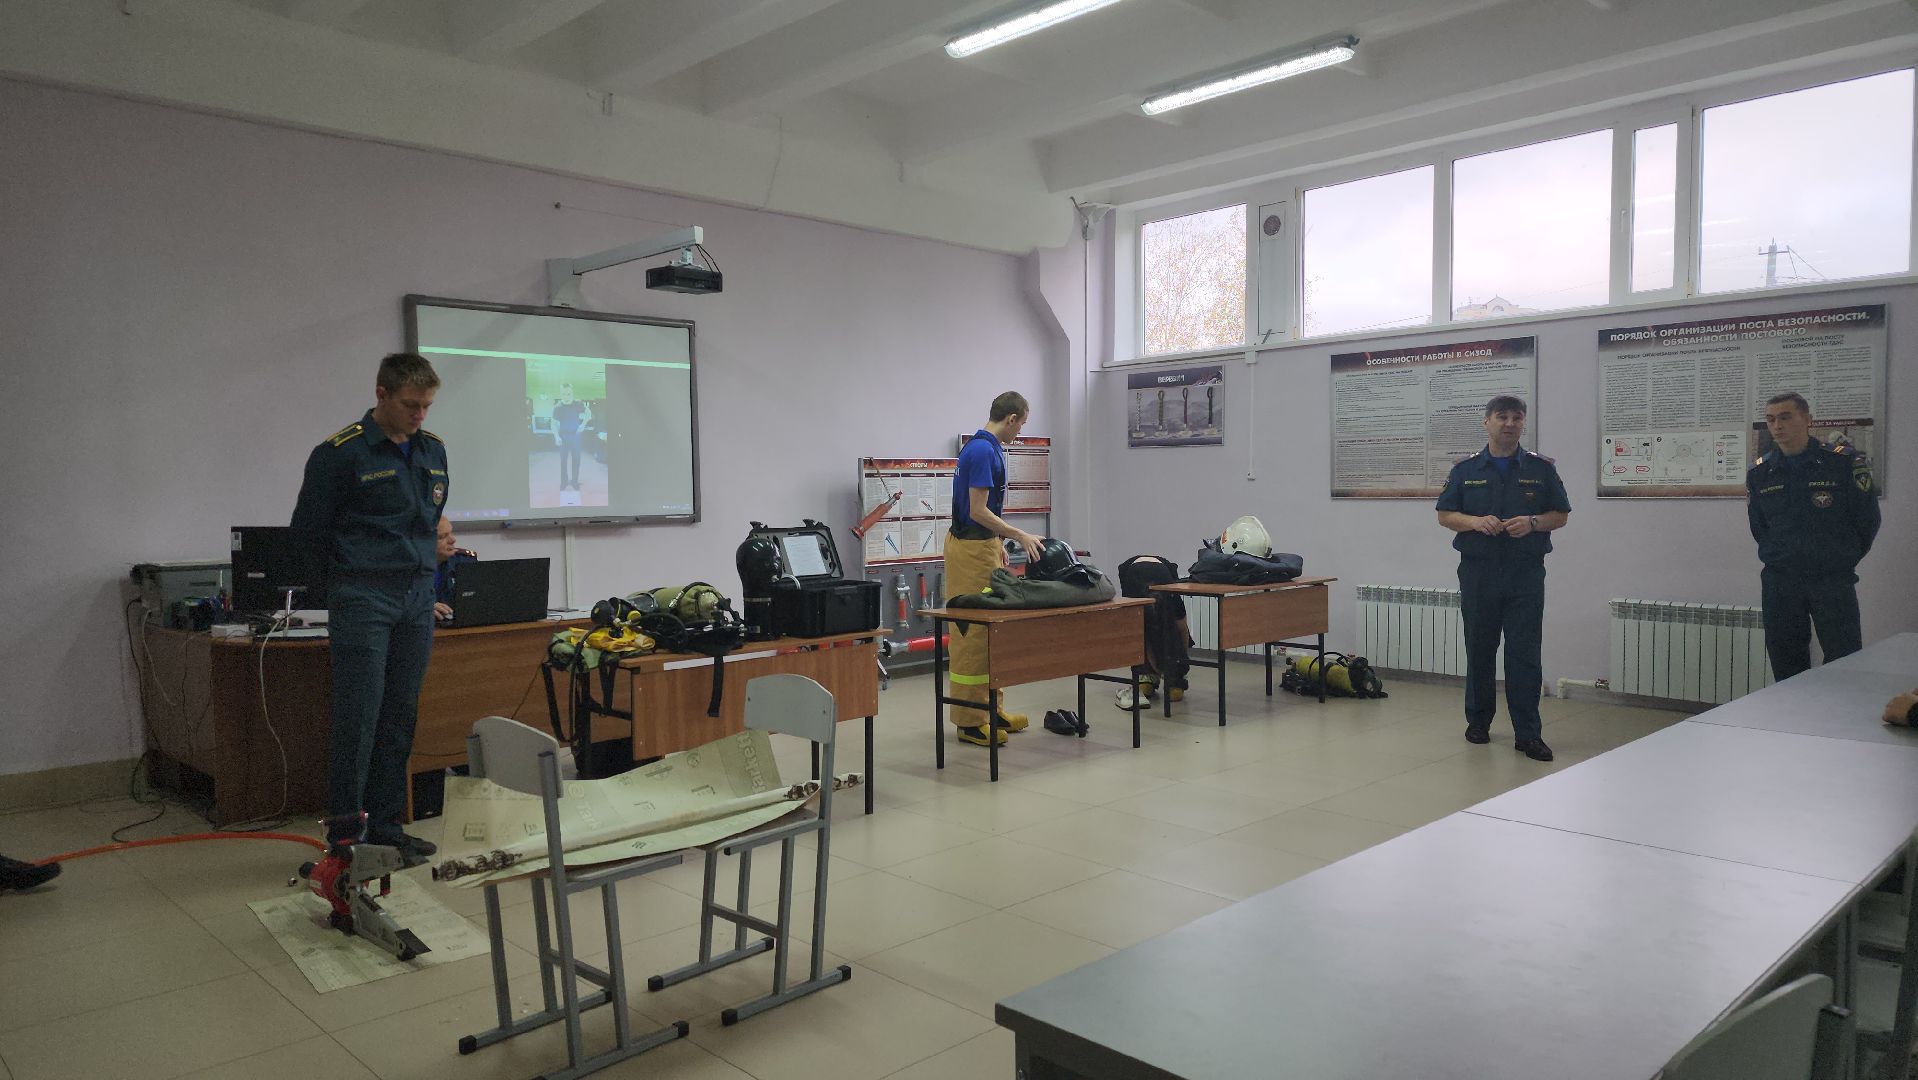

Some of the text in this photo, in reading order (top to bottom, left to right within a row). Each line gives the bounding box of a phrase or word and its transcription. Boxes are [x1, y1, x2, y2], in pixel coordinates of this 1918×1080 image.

[1610, 311, 1870, 342] ПОРЯДОК ОРГАНИЗАЦИИ ПОСТА БЕЗОПАСНОСТИ.
[1663, 327, 1807, 347] ОБЯЗАННОСТИ ПОСТОВОГО
[1366, 355, 1420, 366] ОСОБЕННОСТИ
[1422, 351, 1454, 362] РАБОТЫ
[1464, 348, 1493, 358] СИЗОД
